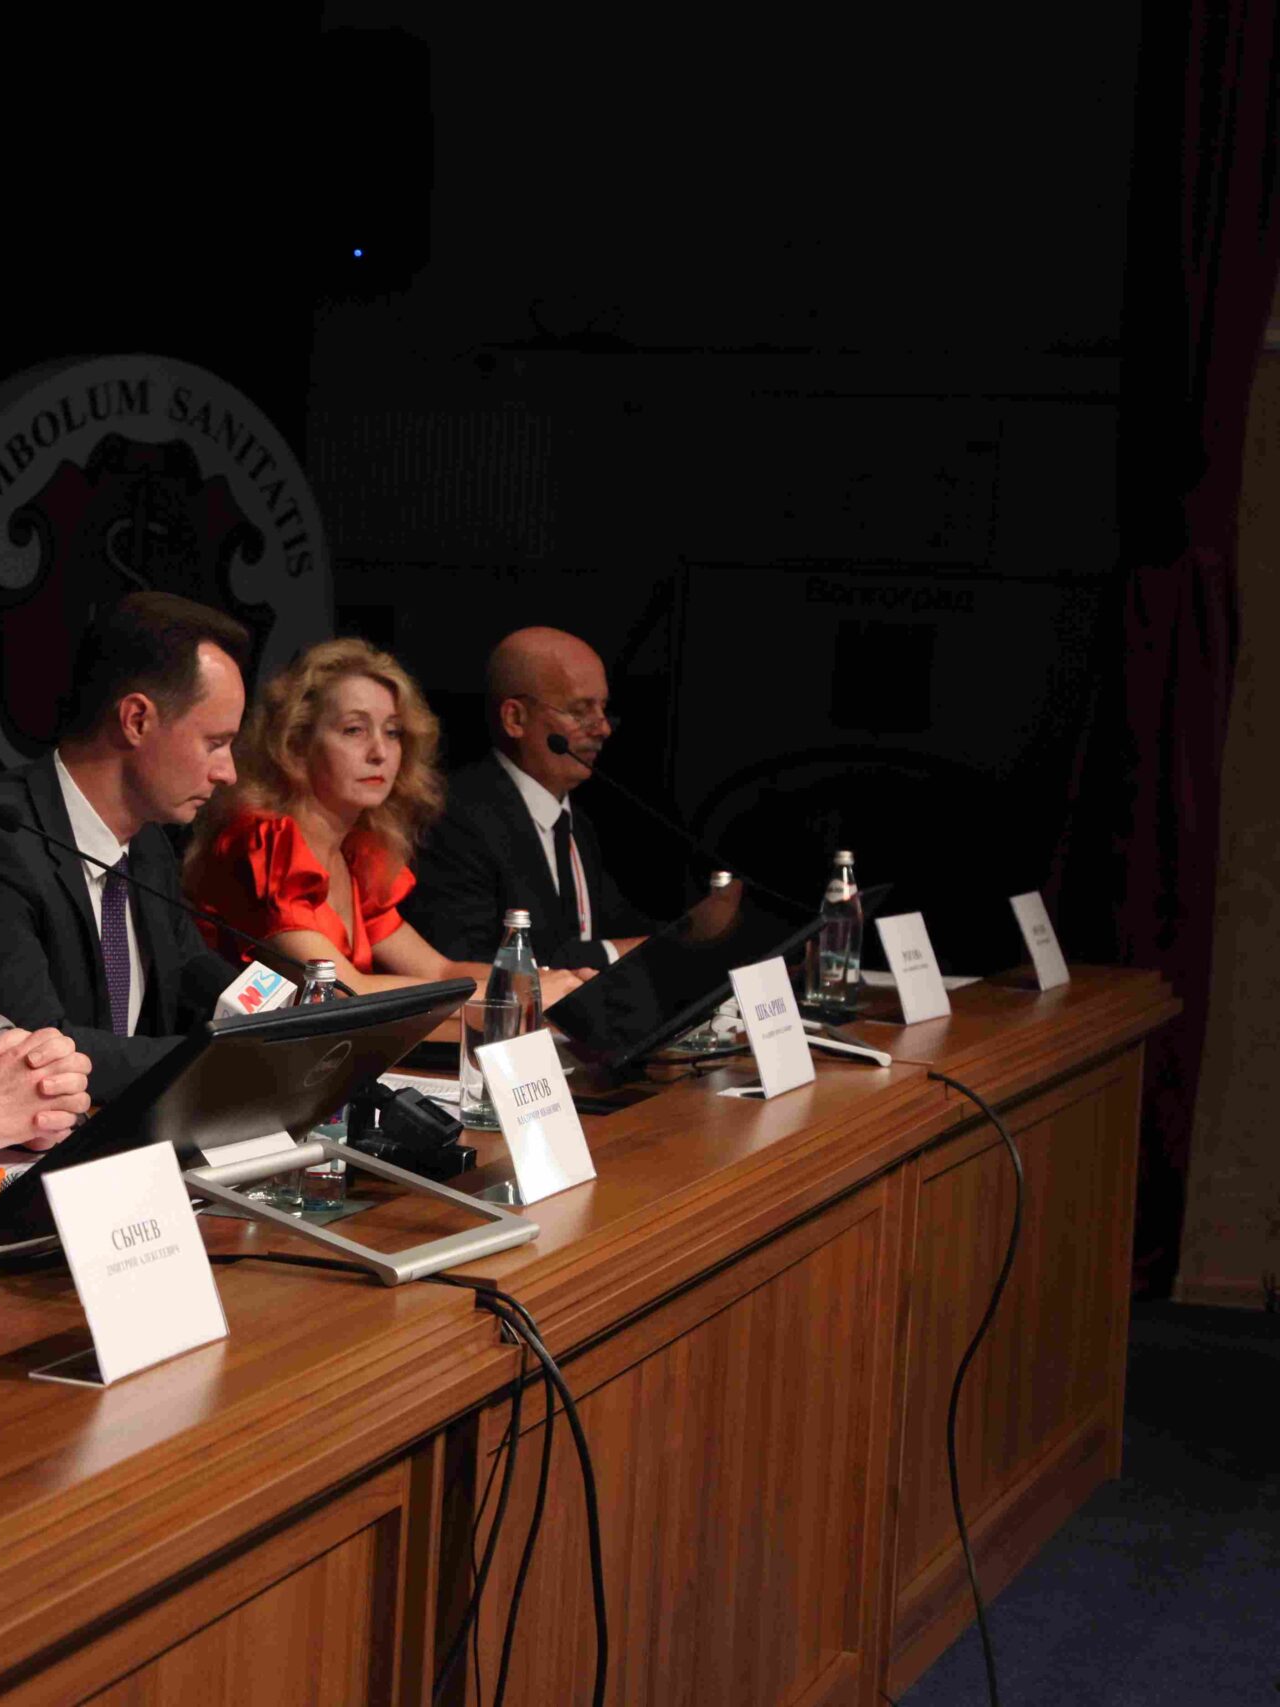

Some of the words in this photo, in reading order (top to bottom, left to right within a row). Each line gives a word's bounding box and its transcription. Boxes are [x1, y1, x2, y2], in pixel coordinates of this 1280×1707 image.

[168, 386, 314, 579] SANITATIS
[512, 1078, 552, 1107] ПЕТРОВ
[111, 1219, 161, 1251] СЫЧЕВ
